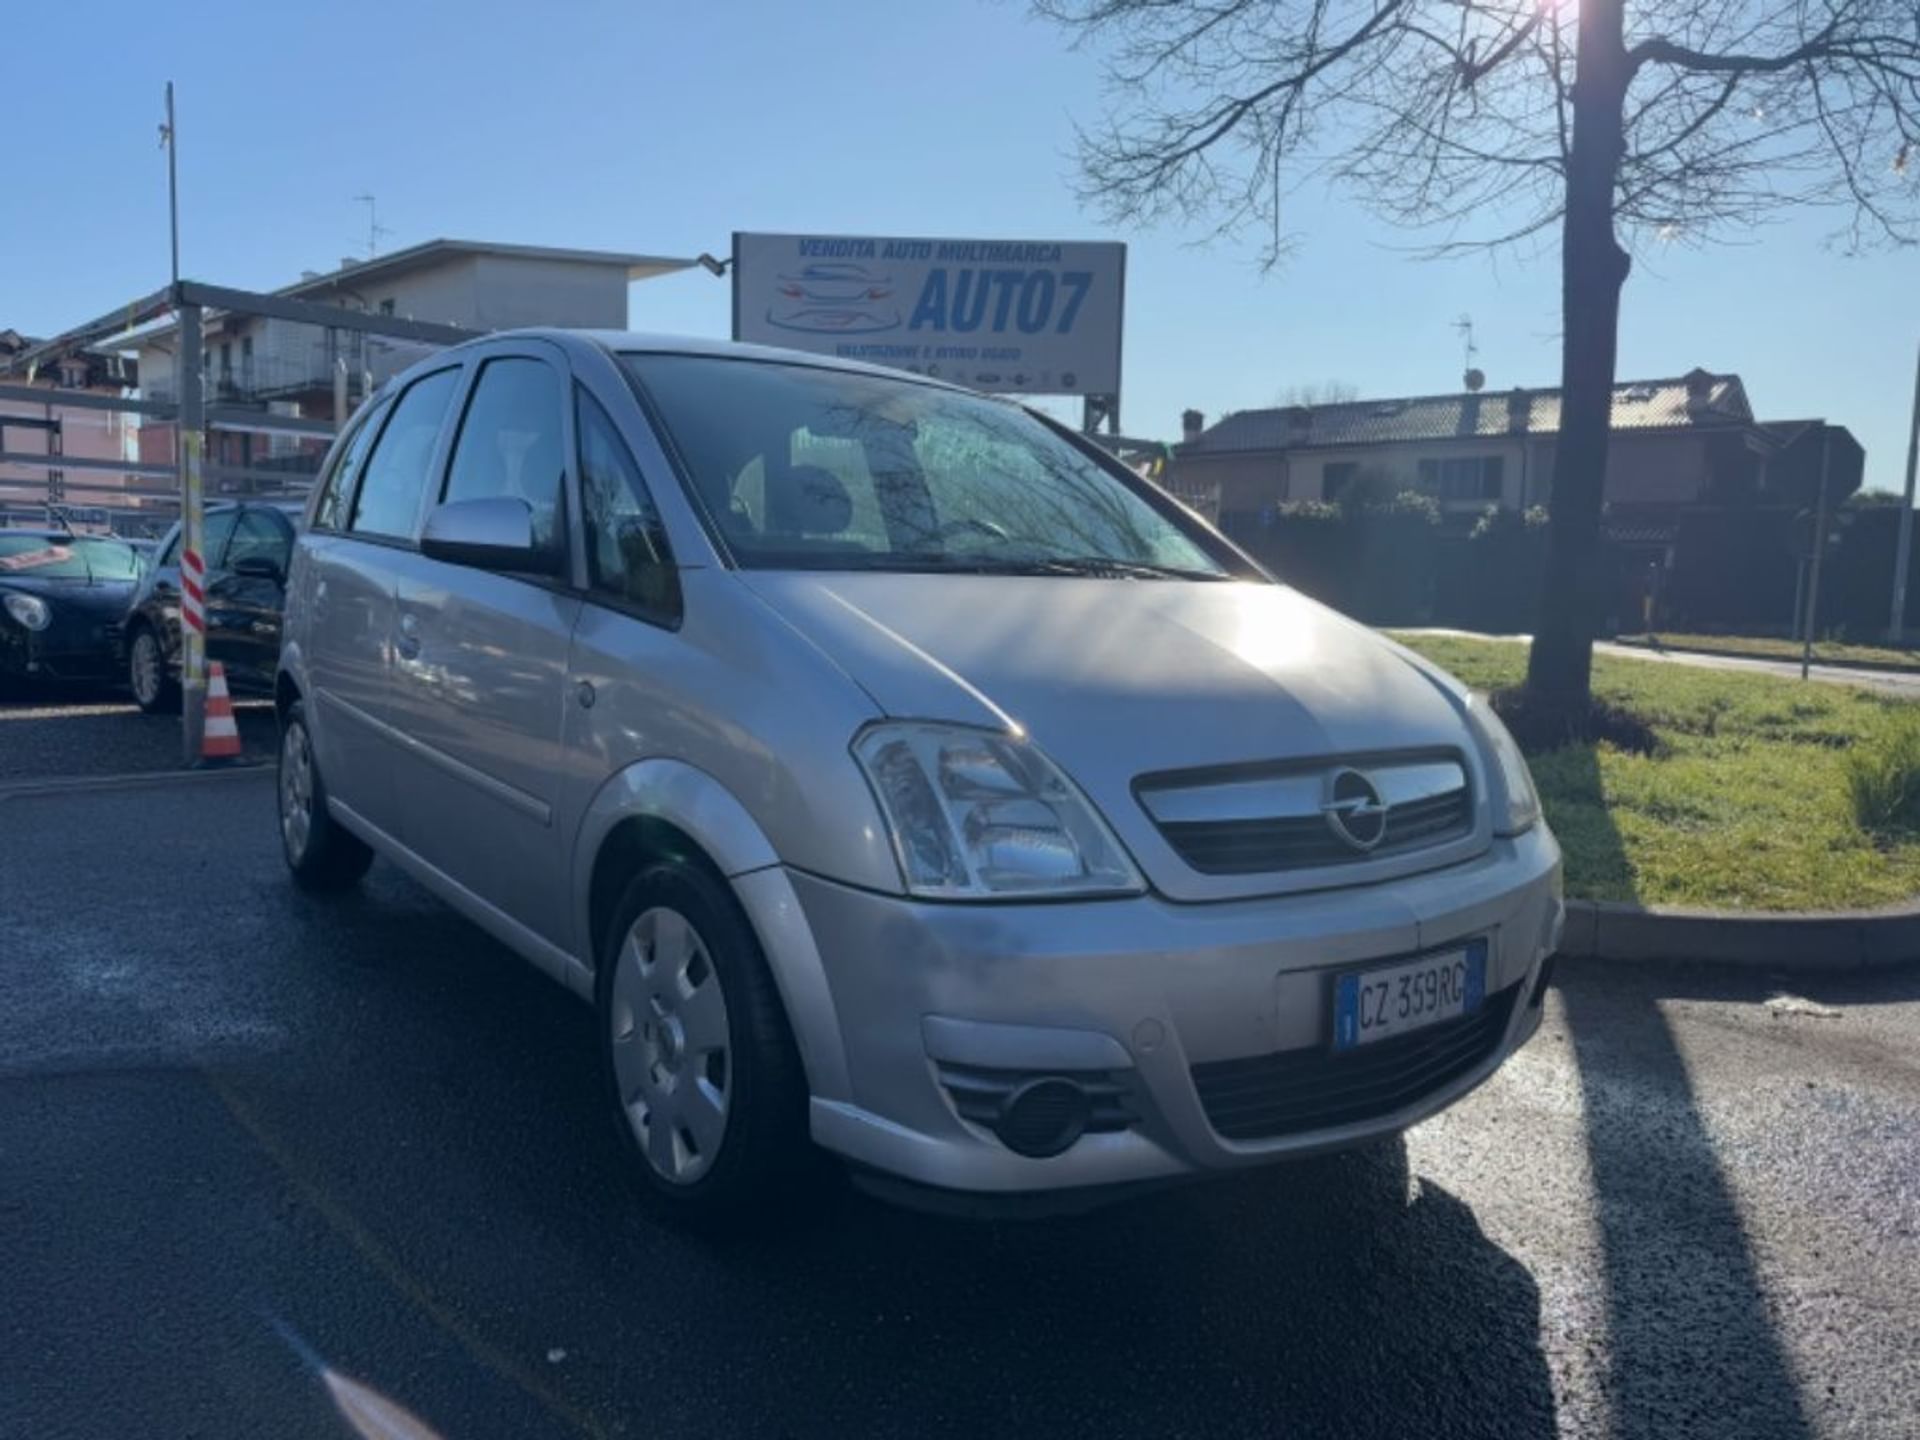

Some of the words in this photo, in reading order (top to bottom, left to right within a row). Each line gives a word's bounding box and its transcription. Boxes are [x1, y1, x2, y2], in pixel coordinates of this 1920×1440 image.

[800, 239, 875, 258] VENDITA
[881, 241, 933, 259] AUTO
[908, 268, 1094, 334] AUTO7
[1360, 980, 1389, 1030] CZ
